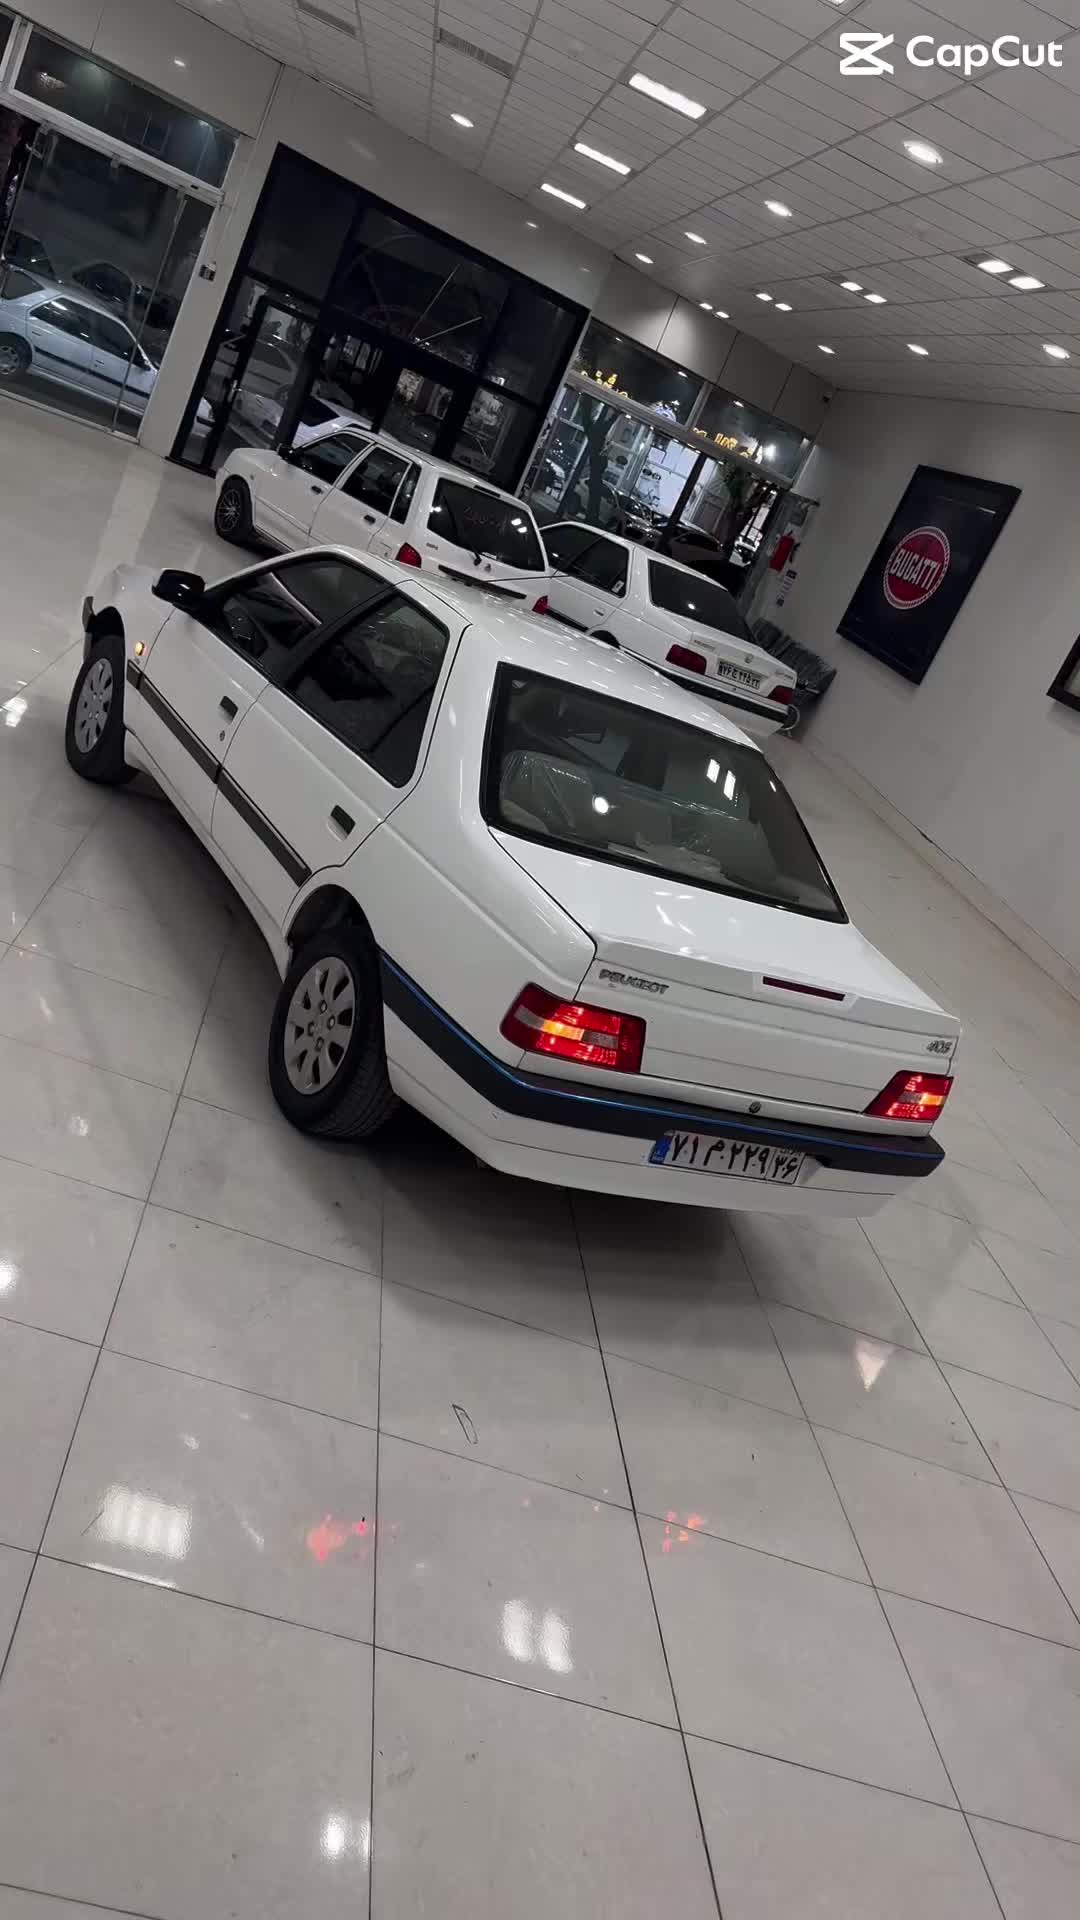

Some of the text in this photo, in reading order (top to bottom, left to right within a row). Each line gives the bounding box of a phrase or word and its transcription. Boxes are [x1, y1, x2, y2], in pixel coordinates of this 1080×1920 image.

[890, 548, 941, 591] BUGATTI
[599, 969, 670, 995] PEUGEOT
[926, 1039, 953, 1054] 405
[672, 1133, 699, 1164] ۷۱
